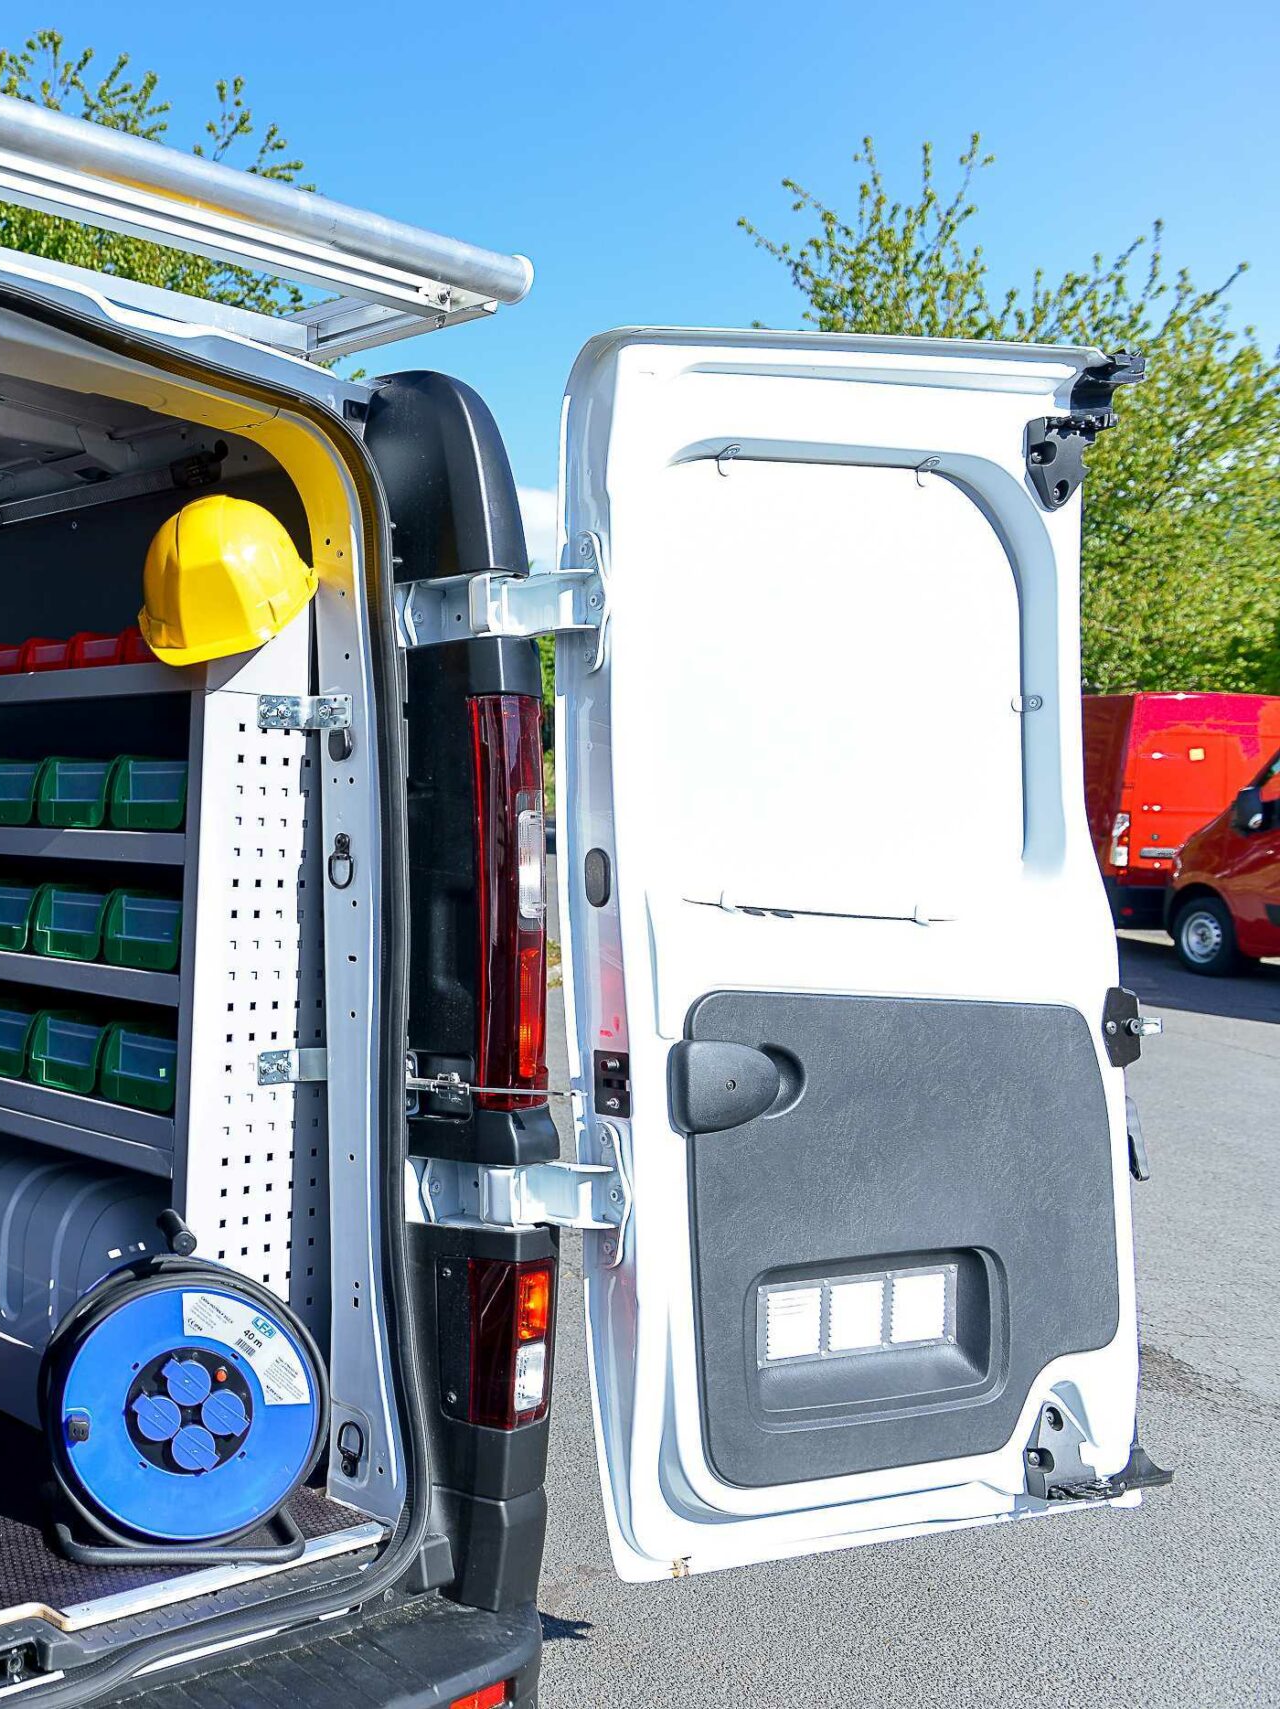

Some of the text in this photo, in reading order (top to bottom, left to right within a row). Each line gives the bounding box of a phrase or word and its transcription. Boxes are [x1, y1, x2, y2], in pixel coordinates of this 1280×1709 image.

[254, 1318, 274, 1337] LFA
[243, 1329, 263, 1348] 40 m
